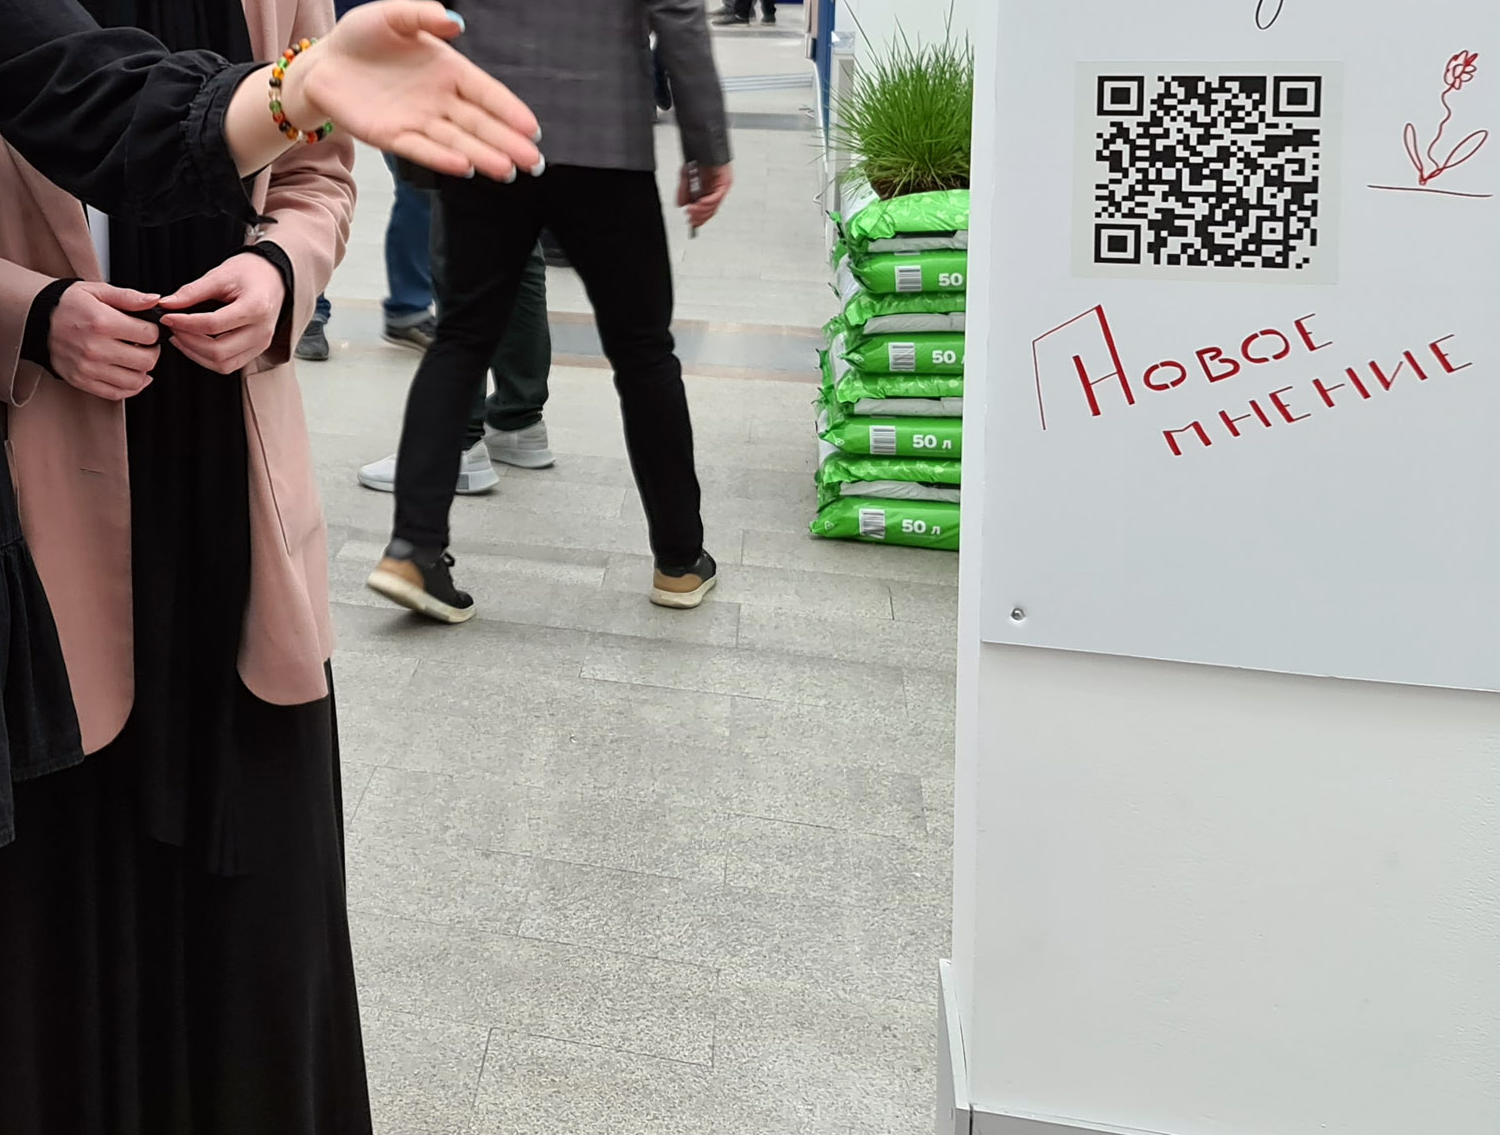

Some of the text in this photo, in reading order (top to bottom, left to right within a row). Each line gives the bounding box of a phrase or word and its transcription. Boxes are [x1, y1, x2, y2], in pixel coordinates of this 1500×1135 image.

[938, 271, 964, 287] 50
[931, 349, 957, 365] 50
[911, 433, 952, 449] 50 л
[901, 519, 941, 535] 50 л
